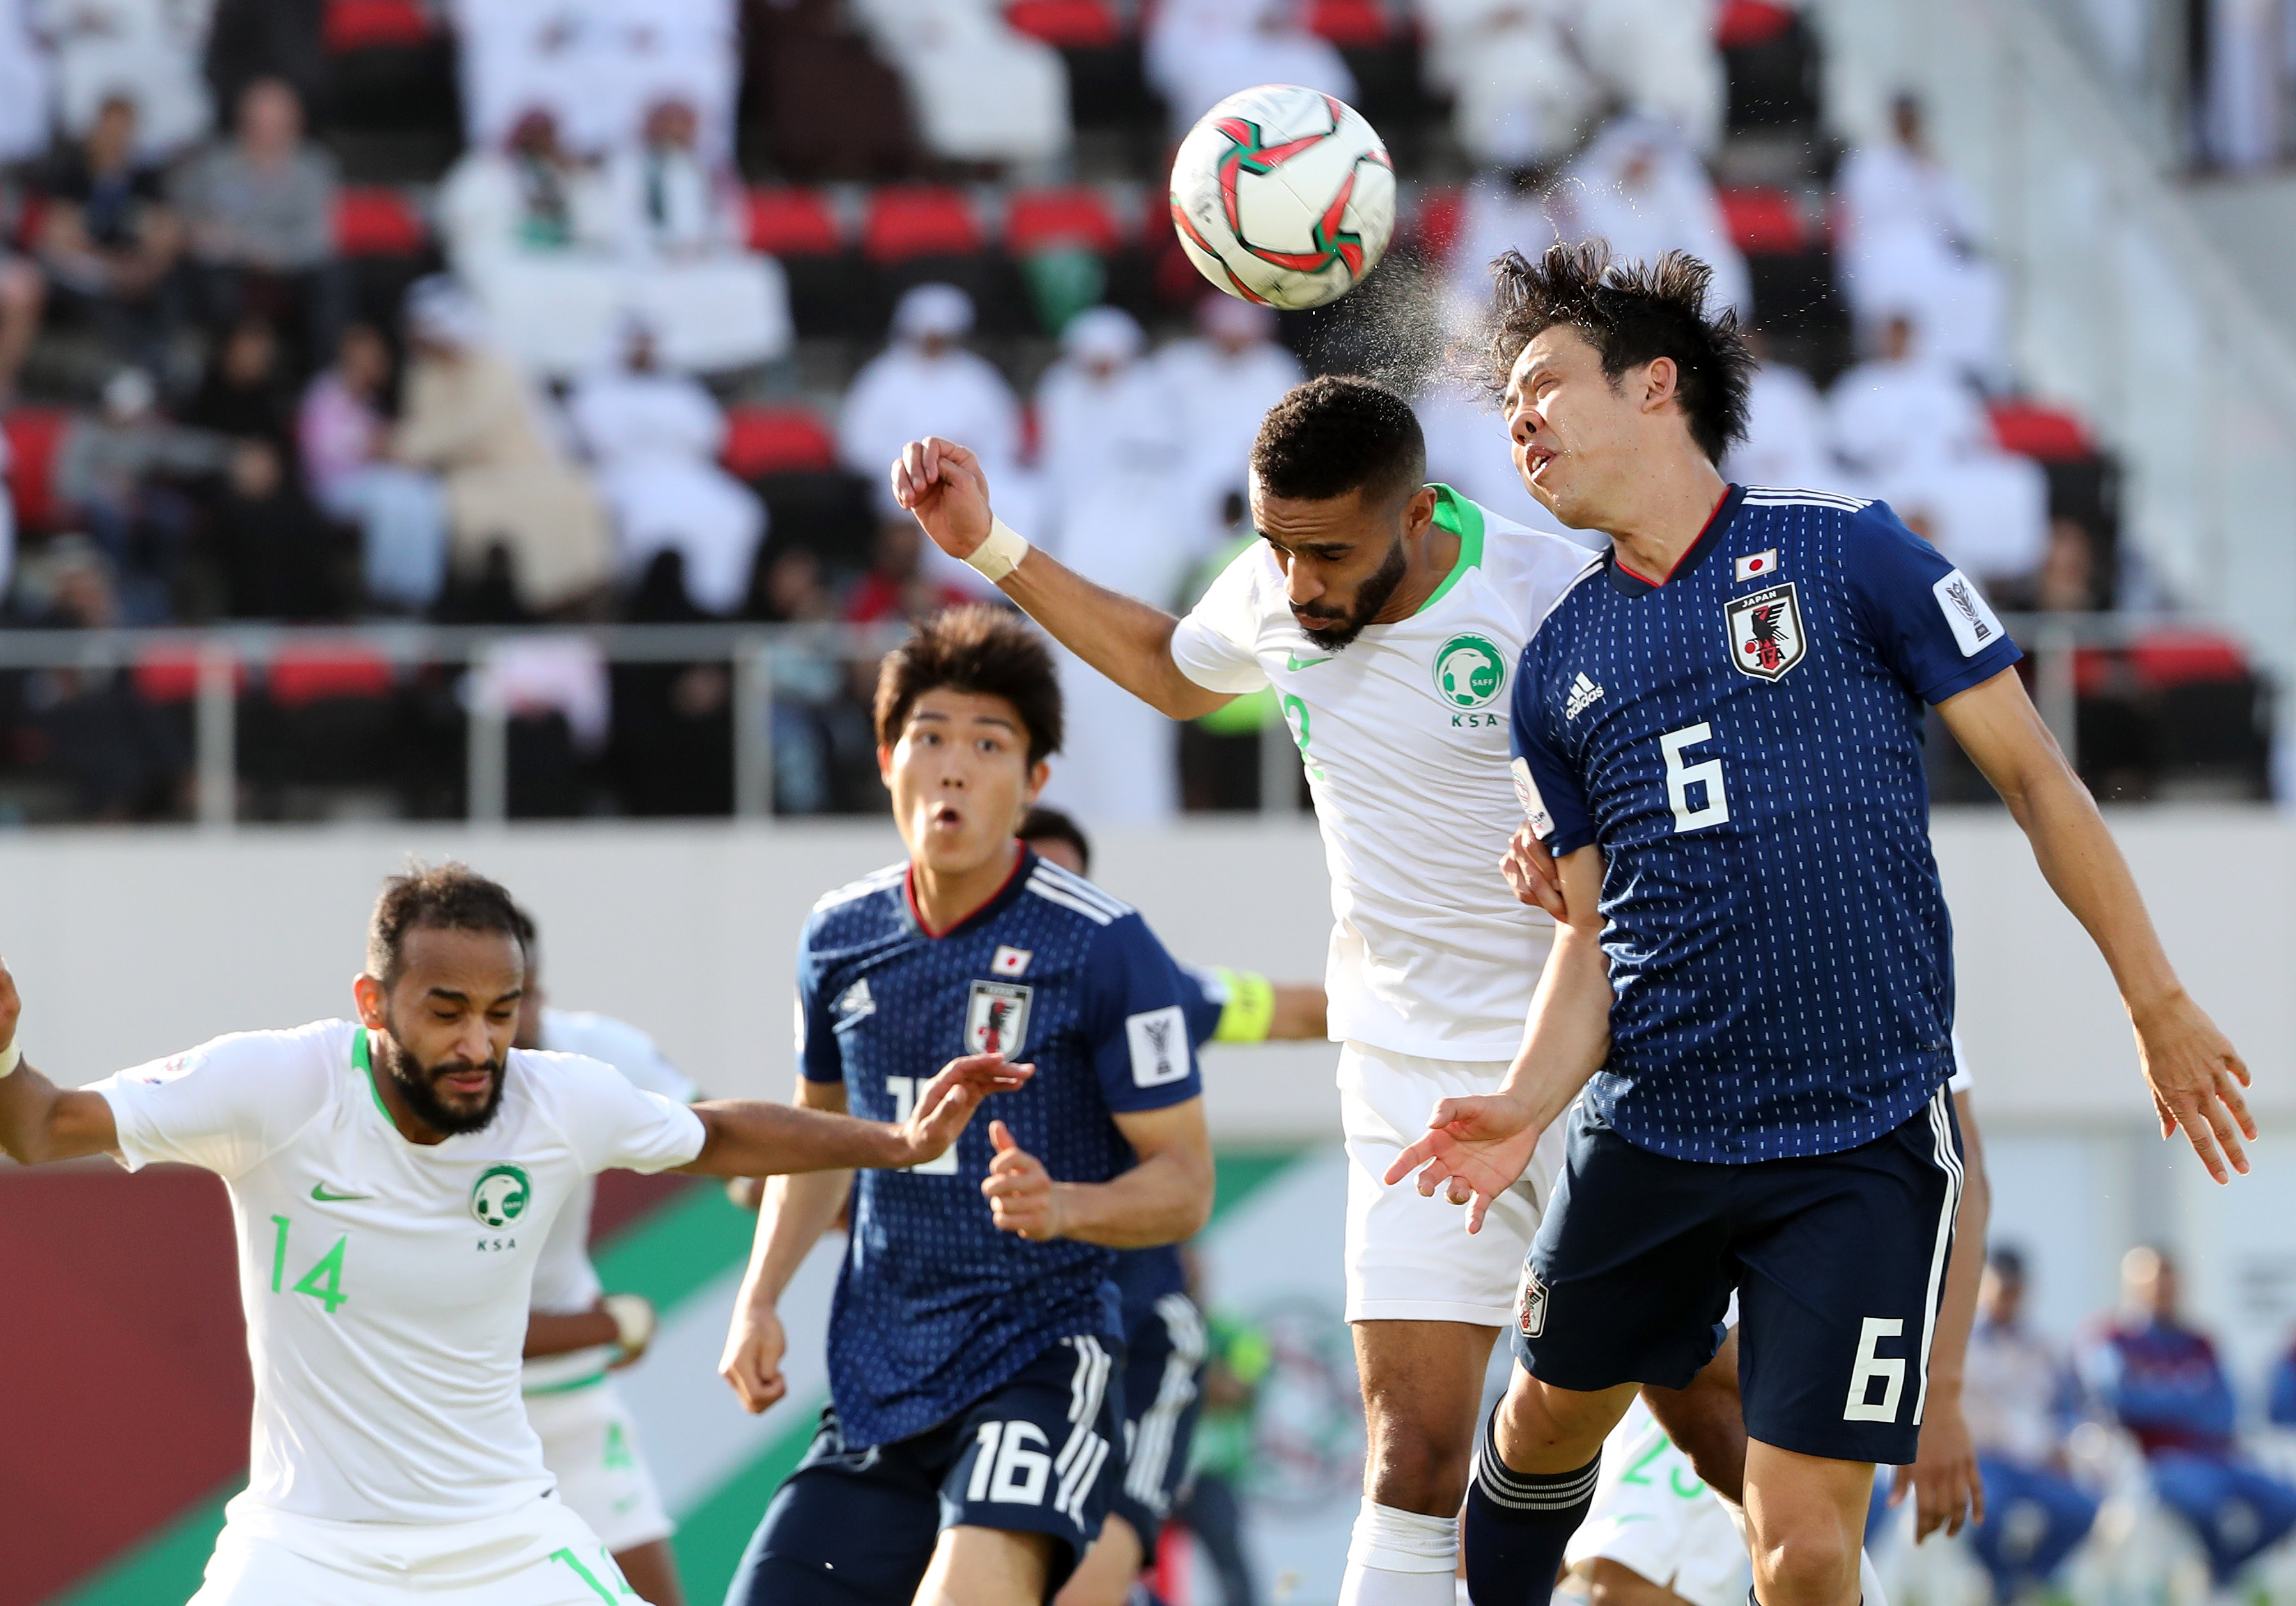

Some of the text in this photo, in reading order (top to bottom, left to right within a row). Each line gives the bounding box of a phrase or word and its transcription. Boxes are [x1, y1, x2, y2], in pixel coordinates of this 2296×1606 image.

[1742, 590, 1777, 608] JAPAN
[1471, 678, 1494, 687] SAFF
[1566, 686, 1604, 720] adidas
[1659, 721, 1730, 833] 6
[271, 1213, 348, 1314] 14
[1843, 1317, 1905, 1423] 6
[966, 1419, 1052, 1506] 16
